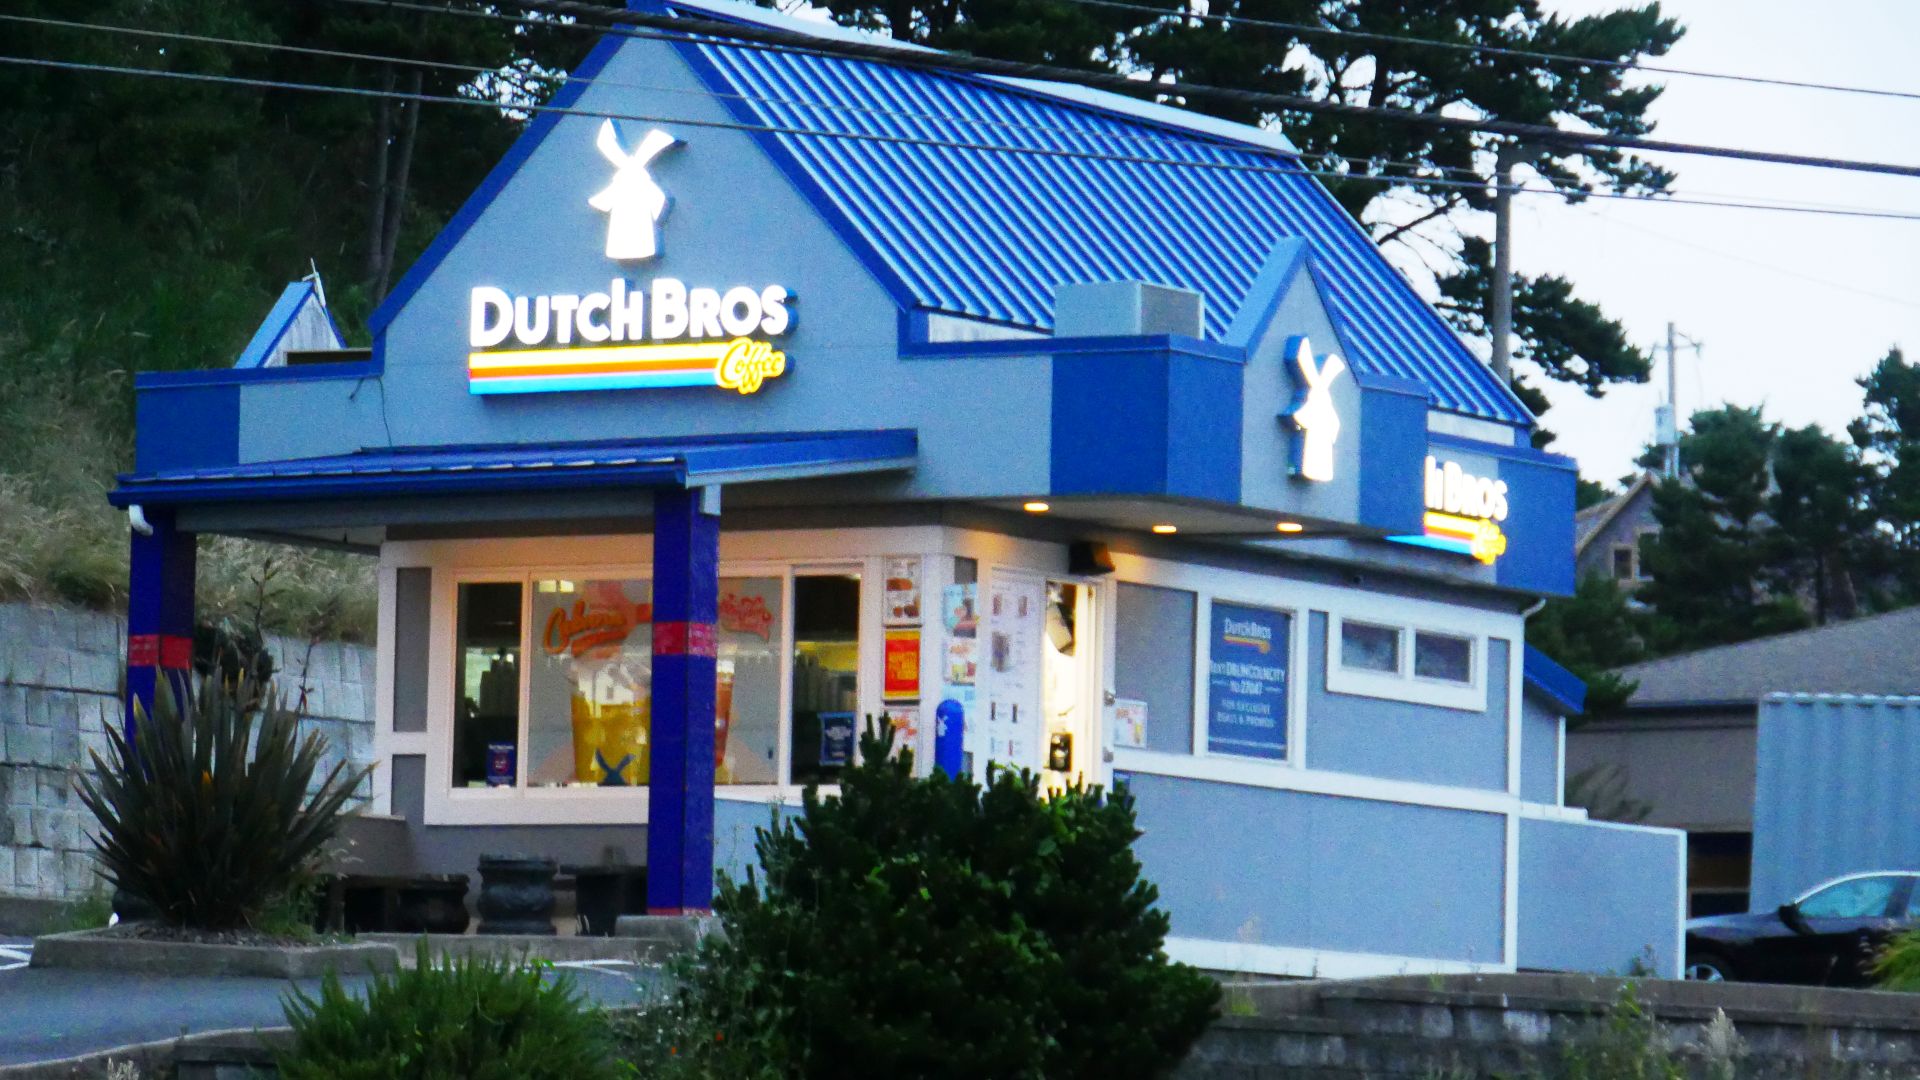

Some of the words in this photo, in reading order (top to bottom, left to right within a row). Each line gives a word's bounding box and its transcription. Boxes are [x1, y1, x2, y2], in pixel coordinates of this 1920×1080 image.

[470, 278, 644, 347] DUTCH
[652, 278, 789, 339] BROS
[716, 338, 785, 394] Coffee
